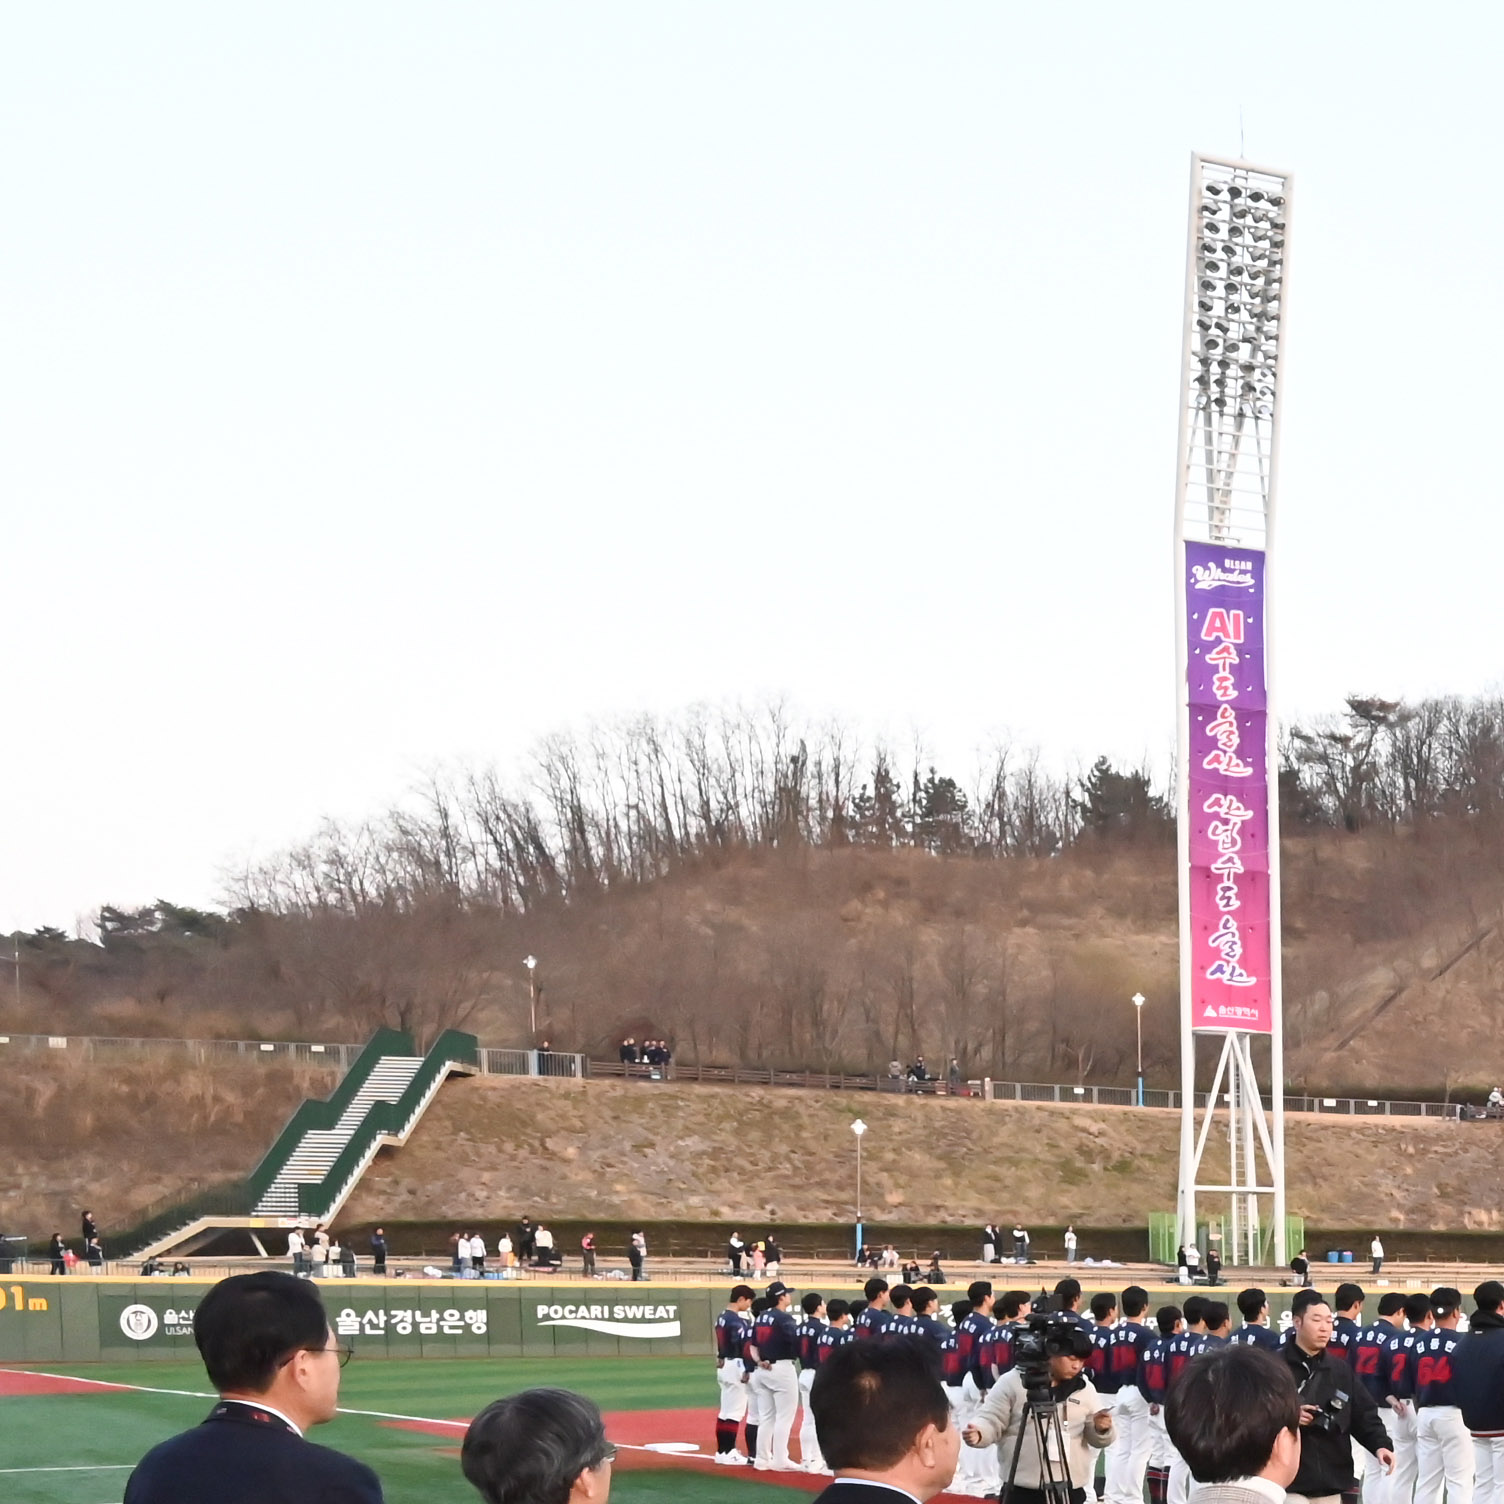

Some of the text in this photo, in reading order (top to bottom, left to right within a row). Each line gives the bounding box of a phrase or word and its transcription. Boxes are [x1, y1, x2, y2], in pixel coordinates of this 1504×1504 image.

[1192, 562, 1254, 585] Whales
[1203, 703, 1254, 777] 울산
[1206, 914, 1257, 986] 울산
[164, 1308, 195, 1325] 울산
[537, 1305, 677, 1319] POCARI SWEAT
